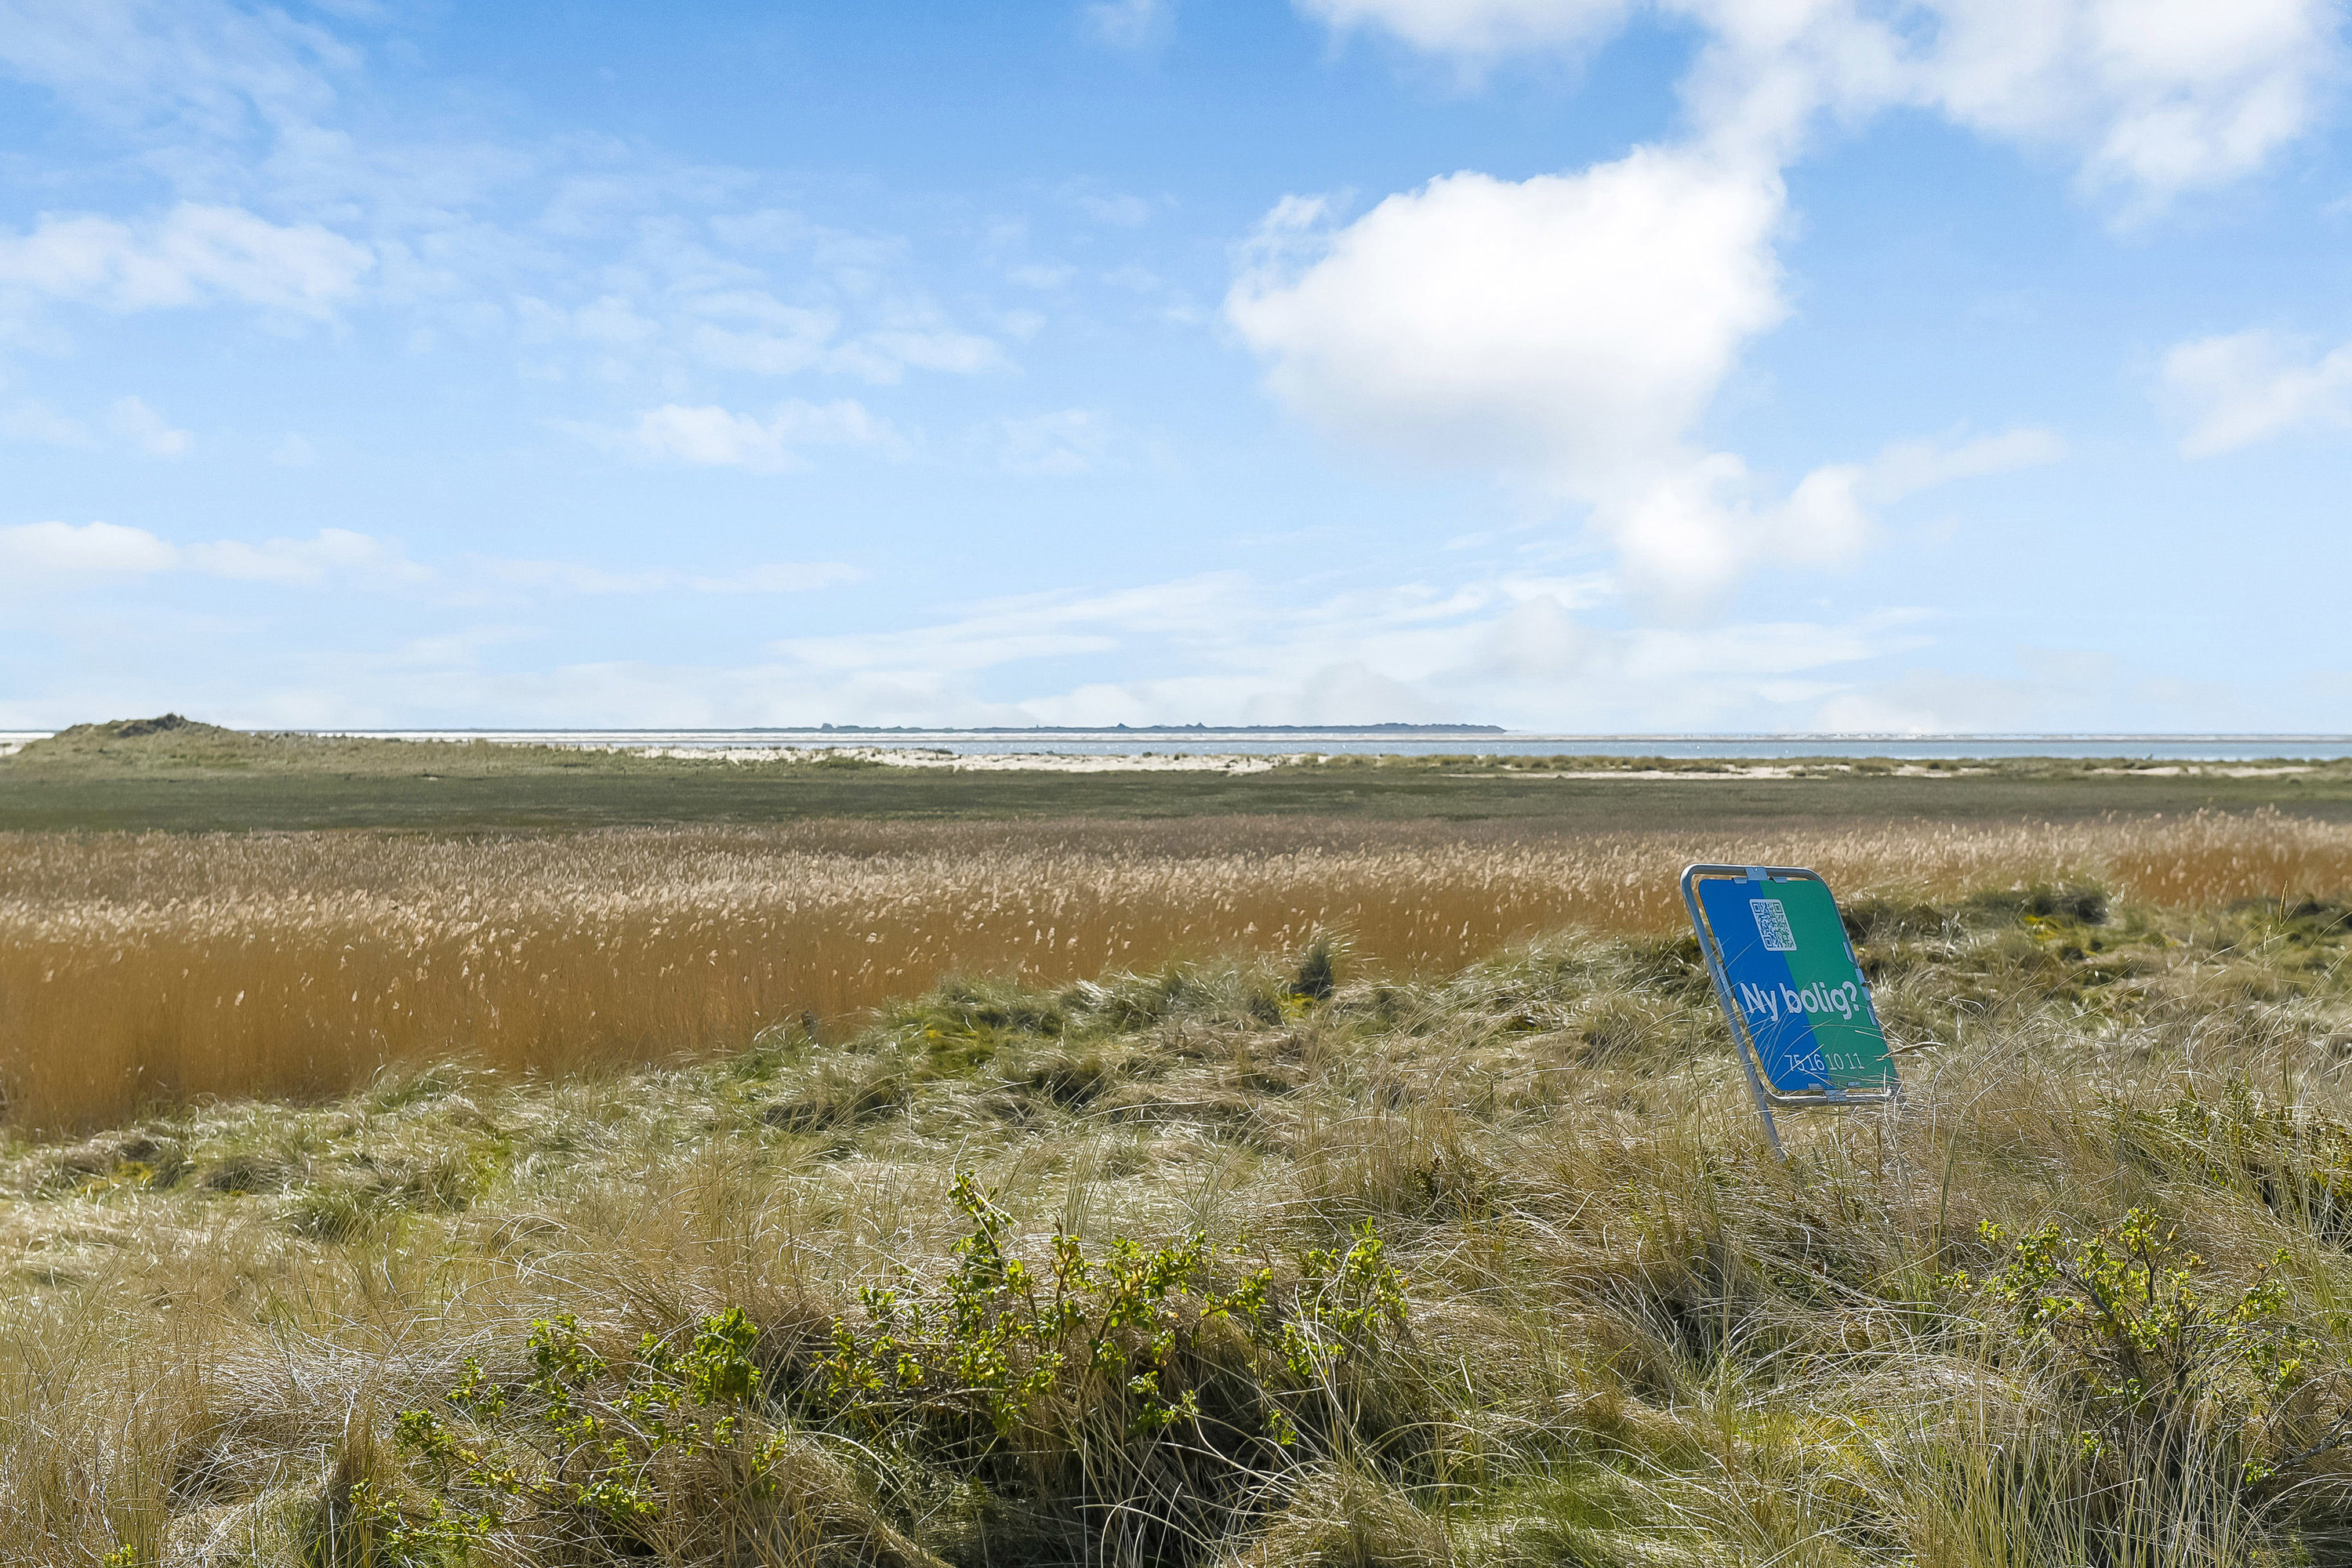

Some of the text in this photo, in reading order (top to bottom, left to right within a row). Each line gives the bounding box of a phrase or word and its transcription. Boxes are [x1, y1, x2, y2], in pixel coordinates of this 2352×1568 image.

[1740, 981, 1860, 1022] Ny bolig?
[1784, 1052, 1865, 1072] 75 16 10 11
